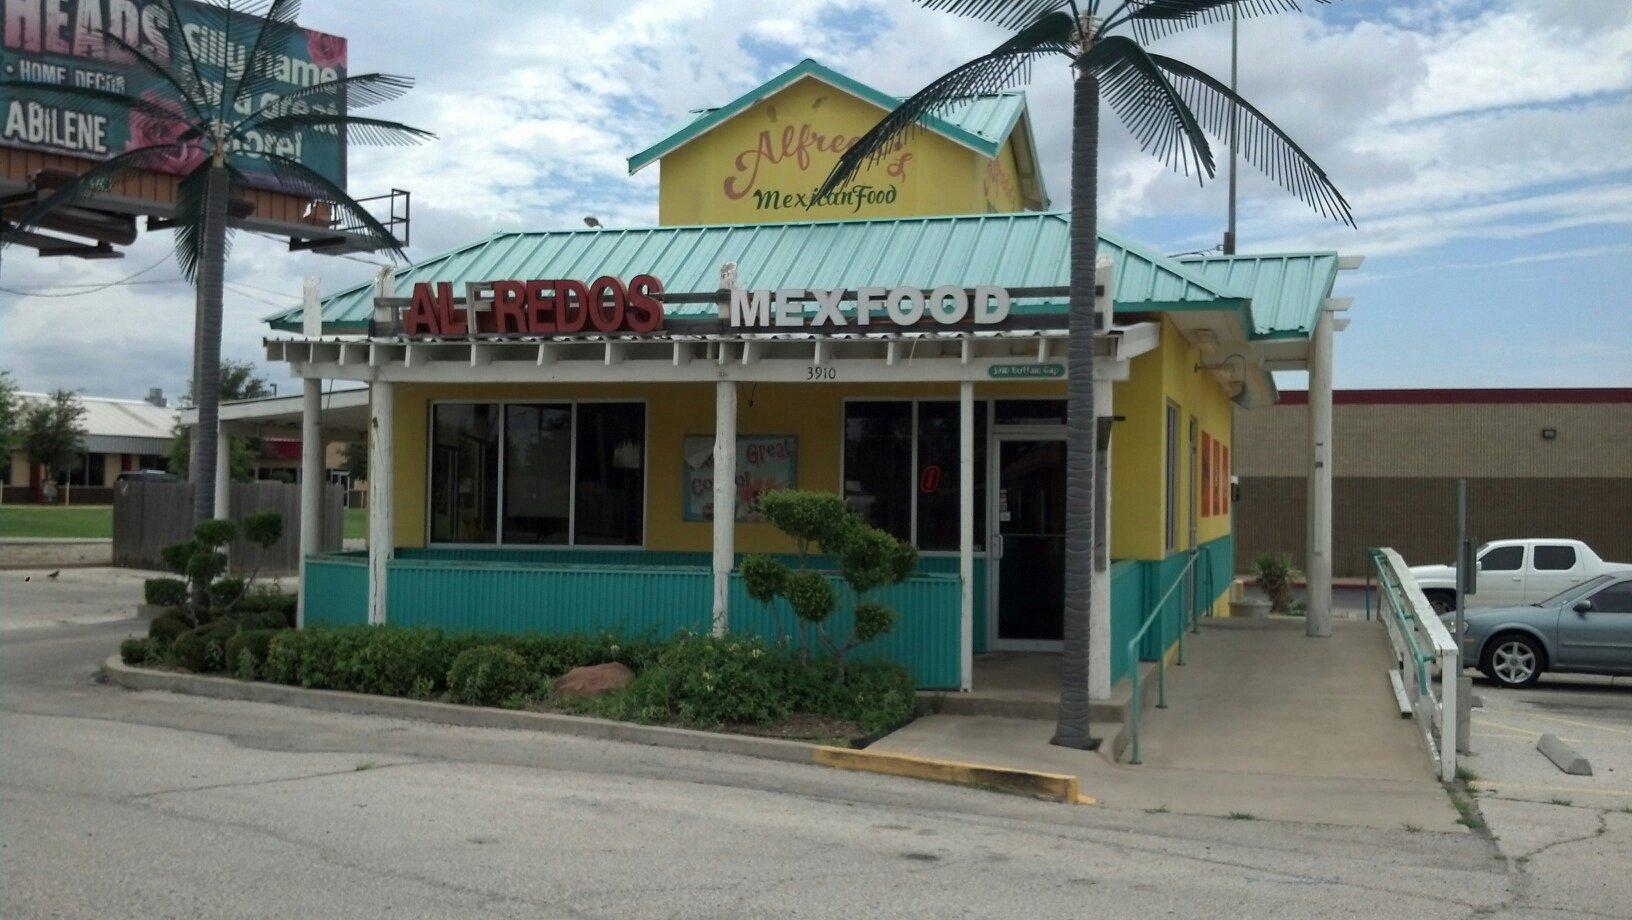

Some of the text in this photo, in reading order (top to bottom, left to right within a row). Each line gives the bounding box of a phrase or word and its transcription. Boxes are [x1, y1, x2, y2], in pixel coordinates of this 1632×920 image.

[20, 59, 66, 84] HOME
[404, 274, 665, 336] ALFREDOS
[807, 366, 837, 380] 3910
